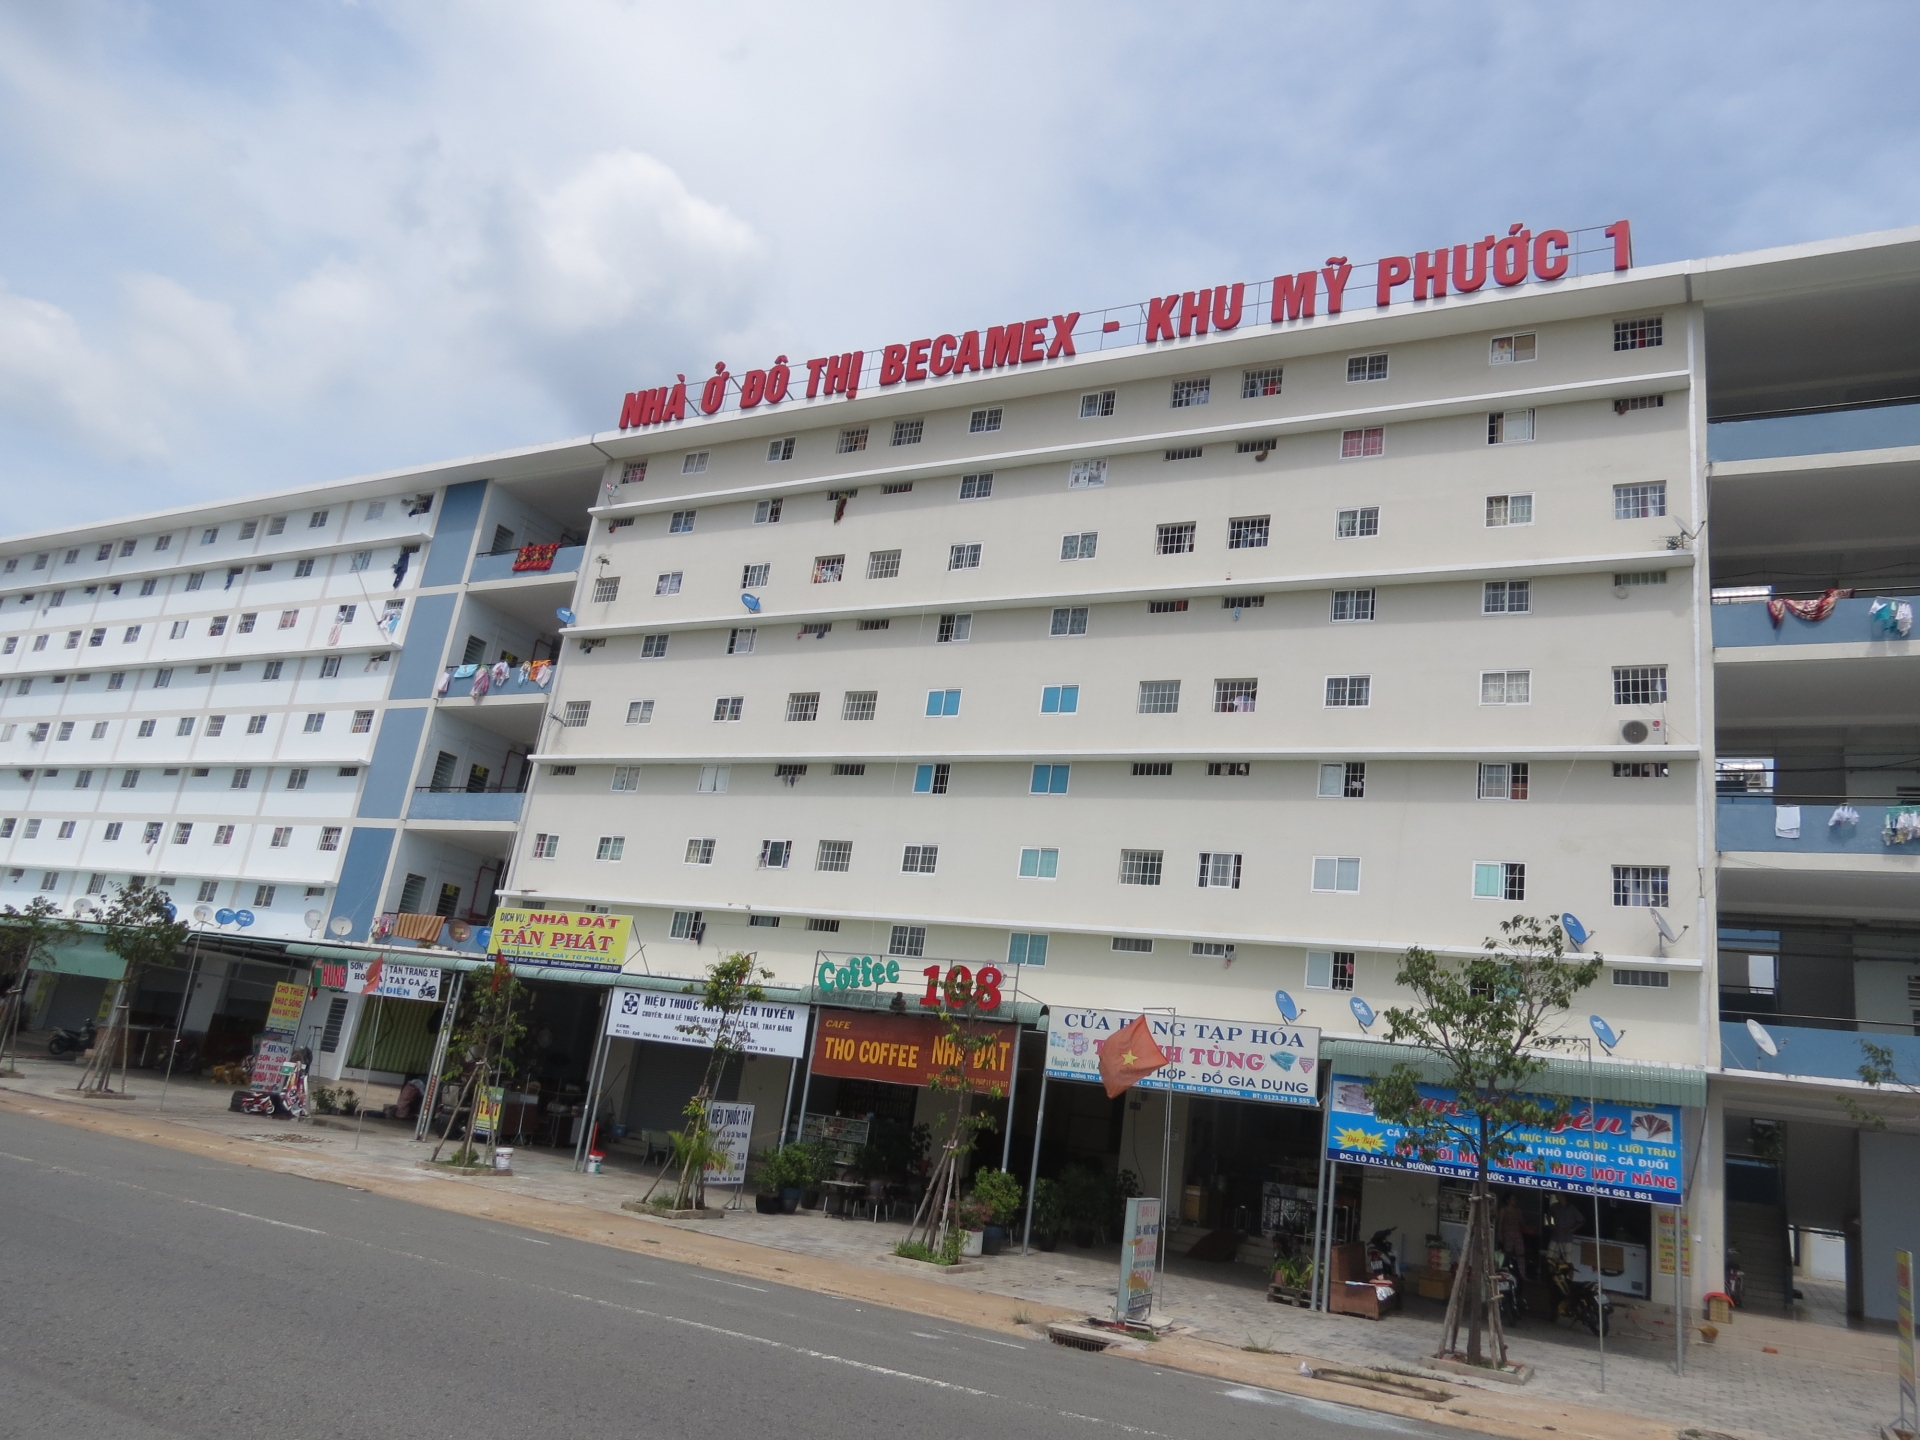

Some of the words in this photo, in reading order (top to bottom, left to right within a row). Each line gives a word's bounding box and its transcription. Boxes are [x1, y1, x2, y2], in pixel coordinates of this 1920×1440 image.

[618, 373, 686, 428] NHÀ
[700, 361, 729, 415] Ở
[739, 355, 790, 408] ĐÔ
[806, 350, 864, 399] THỊ
[879, 311, 1080, 386] BECAMEX
[1145, 282, 1245, 343] KHU
[1270, 255, 1353, 323] MỸ
[1376, 223, 1569, 306] PHƯỚC
[1605, 220, 1631, 271] 1
[529, 913, 569, 925] NHÀ
[577, 915, 620, 929] ĐẤT
[549, 931, 614, 953] PHÁT
[405, 966, 428, 977] TRANG
[429, 969, 439, 978] XE
[408, 977, 420, 987] GA
[818, 955, 900, 992] Coffee
[919, 964, 1002, 1010] 108
[644, 994, 666, 1009] HIỆU
[669, 997, 699, 1011] THUỐC
[825, 1019, 852, 1030] CAFE
[1064, 1008, 1111, 1031] CỬA
[1118, 1016, 1187, 1038] HNG
[1194, 1023, 1243, 1044] TẠP
[1250, 1027, 1305, 1048] HÓA
[825, 1036, 855, 1062] THO
[859, 1040, 920, 1069] COFFEE
[1189, 1045, 1267, 1072] TÙNG
[1202, 1068, 1223, 1084] ĐỒ
[1228, 1075, 1257, 1088] GIA
[1261, 1080, 1309, 1094] DỤNG
[1519, 1132, 1542, 1143] MỰC
[1545, 1134, 1566, 1146] KHÔ
[1576, 1136, 1590, 1148] CÁ
[1646, 1145, 1676, 1158] TRÂU
[1537, 1145, 1562, 1157] KHÔ
[1618, 1155, 1634, 1166] CÁ
[1406, 1160, 1437, 1173] ĐƯỜNG
[1439, 1166, 1455, 1175] TC1
[1457, 1166, 1472, 1178] MỸ
[1519, 1174, 1538, 1186] BẾN
[1540, 1177, 1562, 1189] CÁT,
[1567, 1183, 1583, 1192] ĐT:
[1612, 1188, 1631, 1198] 661
[1634, 1191, 1653, 1201] 861
[1591, 1167, 1627, 1184] MỘT
[1631, 1168, 1677, 1190] NẮNG
